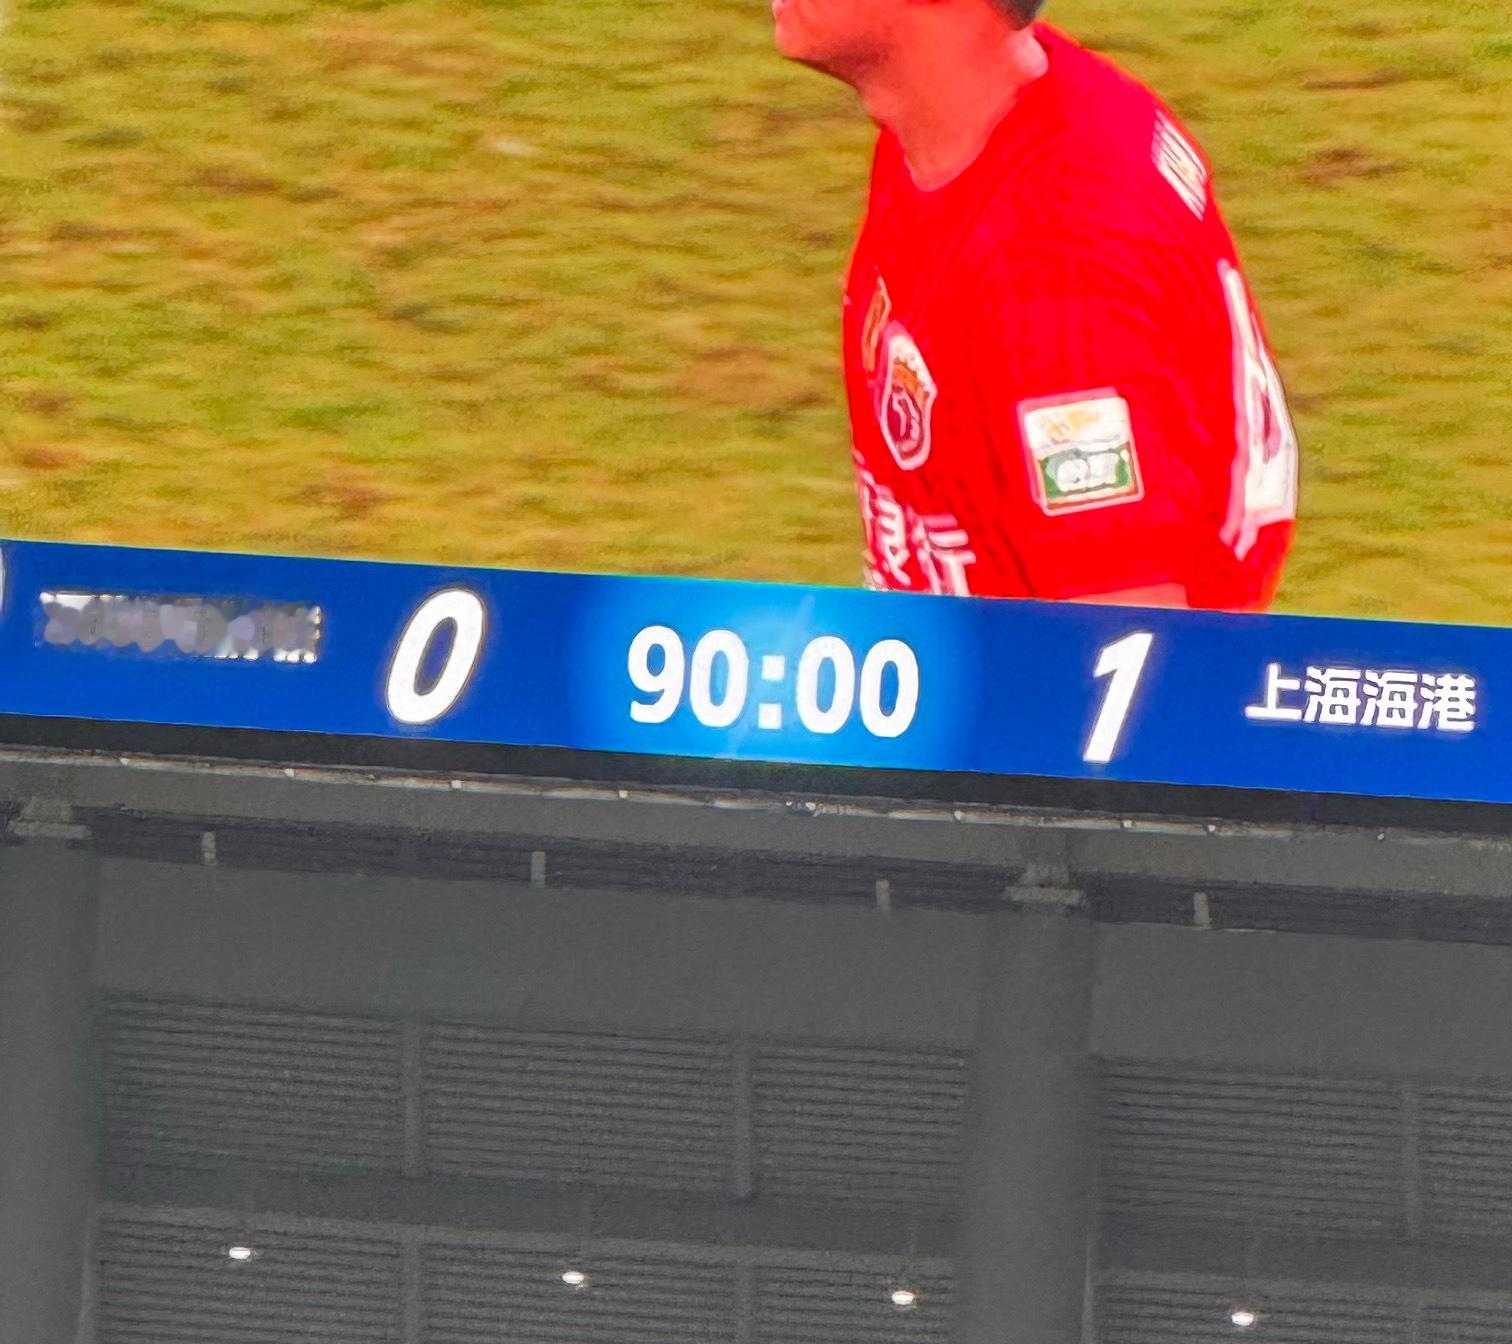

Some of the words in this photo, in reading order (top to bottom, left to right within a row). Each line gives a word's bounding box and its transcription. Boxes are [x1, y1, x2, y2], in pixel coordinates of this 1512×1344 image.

[387, 588, 486, 725] 0
[628, 625, 920, 738] 90:00
[1083, 632, 1153, 763] 1
[1245, 663, 1477, 732] 上海海港
